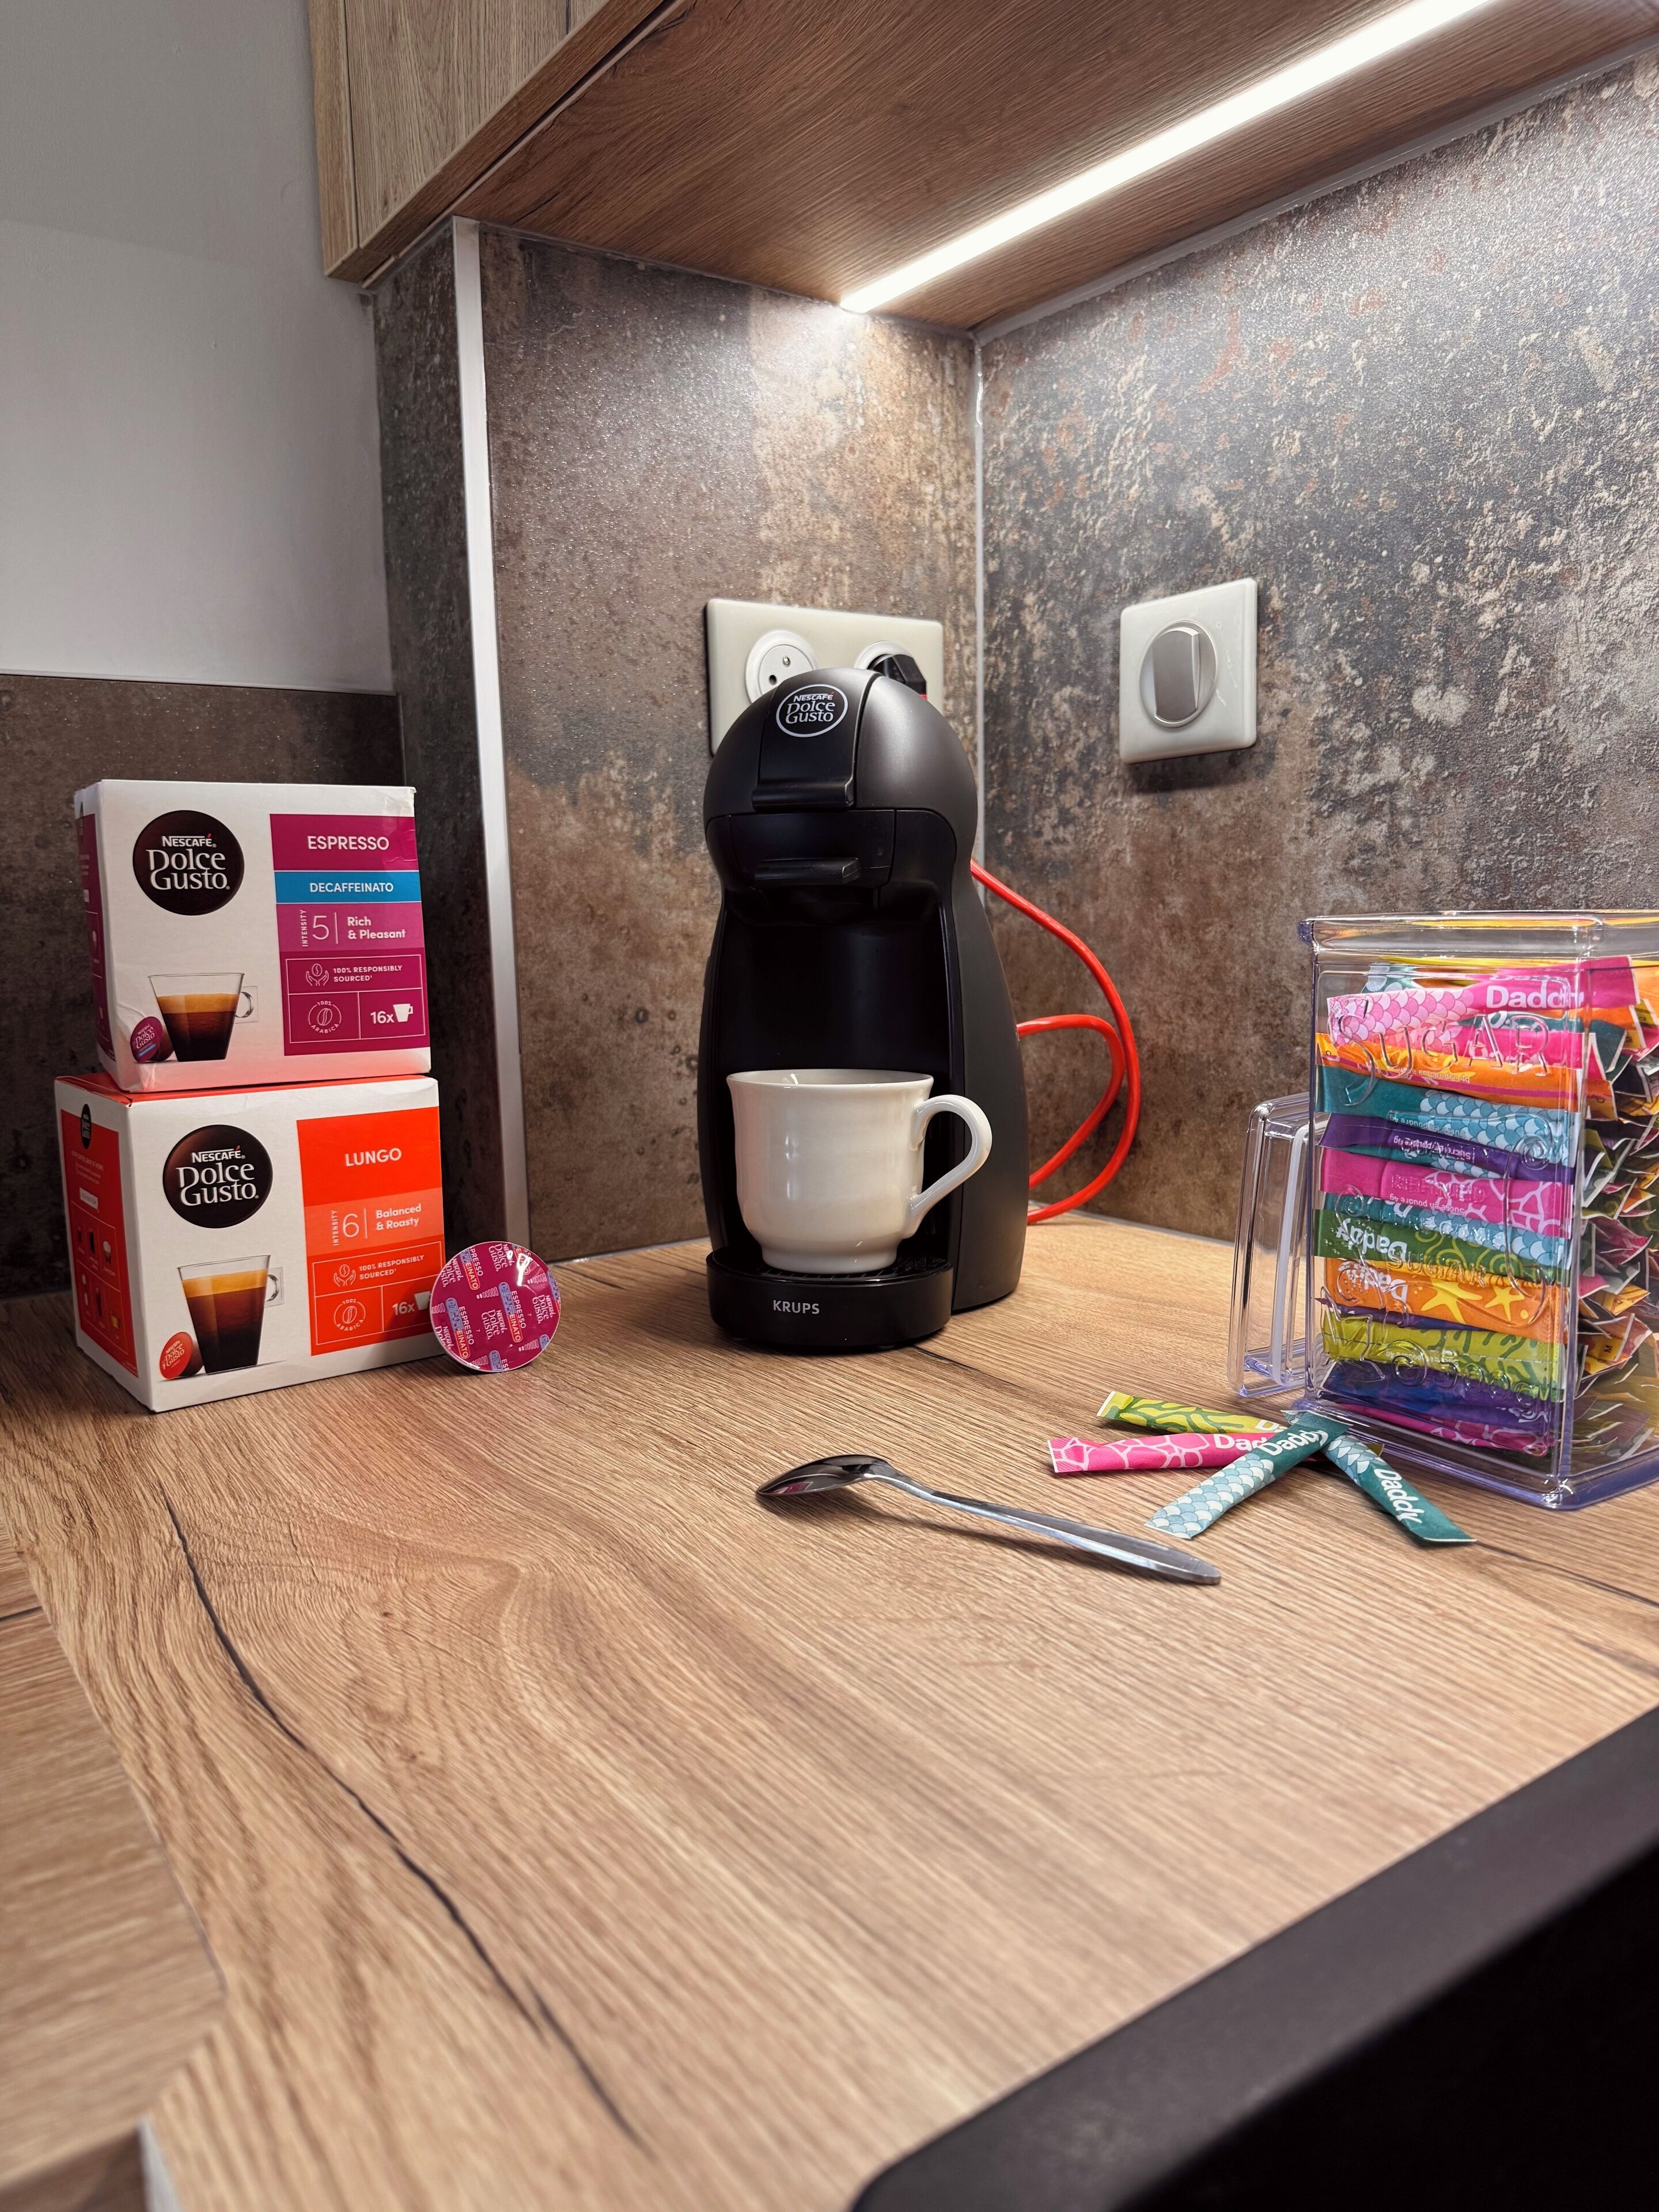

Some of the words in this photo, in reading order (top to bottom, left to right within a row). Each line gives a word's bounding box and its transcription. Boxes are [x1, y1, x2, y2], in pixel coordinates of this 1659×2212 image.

[787, 700, 835, 714] Dolce
[785, 711, 834, 724] Gusto
[308, 836, 389, 850] ESPRESSO
[146, 849, 226, 870] Dolce
[150, 869, 228, 890] Gusto
[309, 882, 394, 892] DECAFFEINATO
[300, 910, 309, 947] INTENSITY
[312, 915, 329, 940] 5
[347, 916, 372, 926] Rich
[348, 930, 357, 940] &
[359, 929, 406, 939] Pleasant
[354, 965, 403, 973] RESPONSIBLY
[370, 1010, 395, 1024] 16x
[311, 1023, 340, 1034] ARABICA
[345, 1147, 402, 1166] LUNGO
[176, 1162, 255, 1188] Dolce
[180, 1181, 257, 1206] Gusto
[1389, 1193, 1399, 1202] 4g
[376, 1203, 422, 1219] Balanced
[1400, 1198, 1427, 1209] poudre
[331, 1210, 339, 1246] INTENSITY
[342, 1213, 359, 1238] 6
[376, 1221, 384, 1230] &
[386, 1217, 419, 1229] Roasty
[359, 1264, 376, 1272] 100%
[377, 1255, 425, 1268] RESPONSIBLY
[392, 1301, 415, 1316] 16x
[511, 1290, 527, 1328] ESPRESSO
[537, 1294, 550, 1320] Dolce
[772, 1300, 820, 1315] KRUPS
[336, 1319, 365, 1331] ARABICA
[459, 1306, 475, 1345] ESPRESSO
[487, 1309, 500, 1336] Dolce
[1257, 1430, 1329, 1456] Daddy
[1373, 1468, 1425, 1524] Daddy
